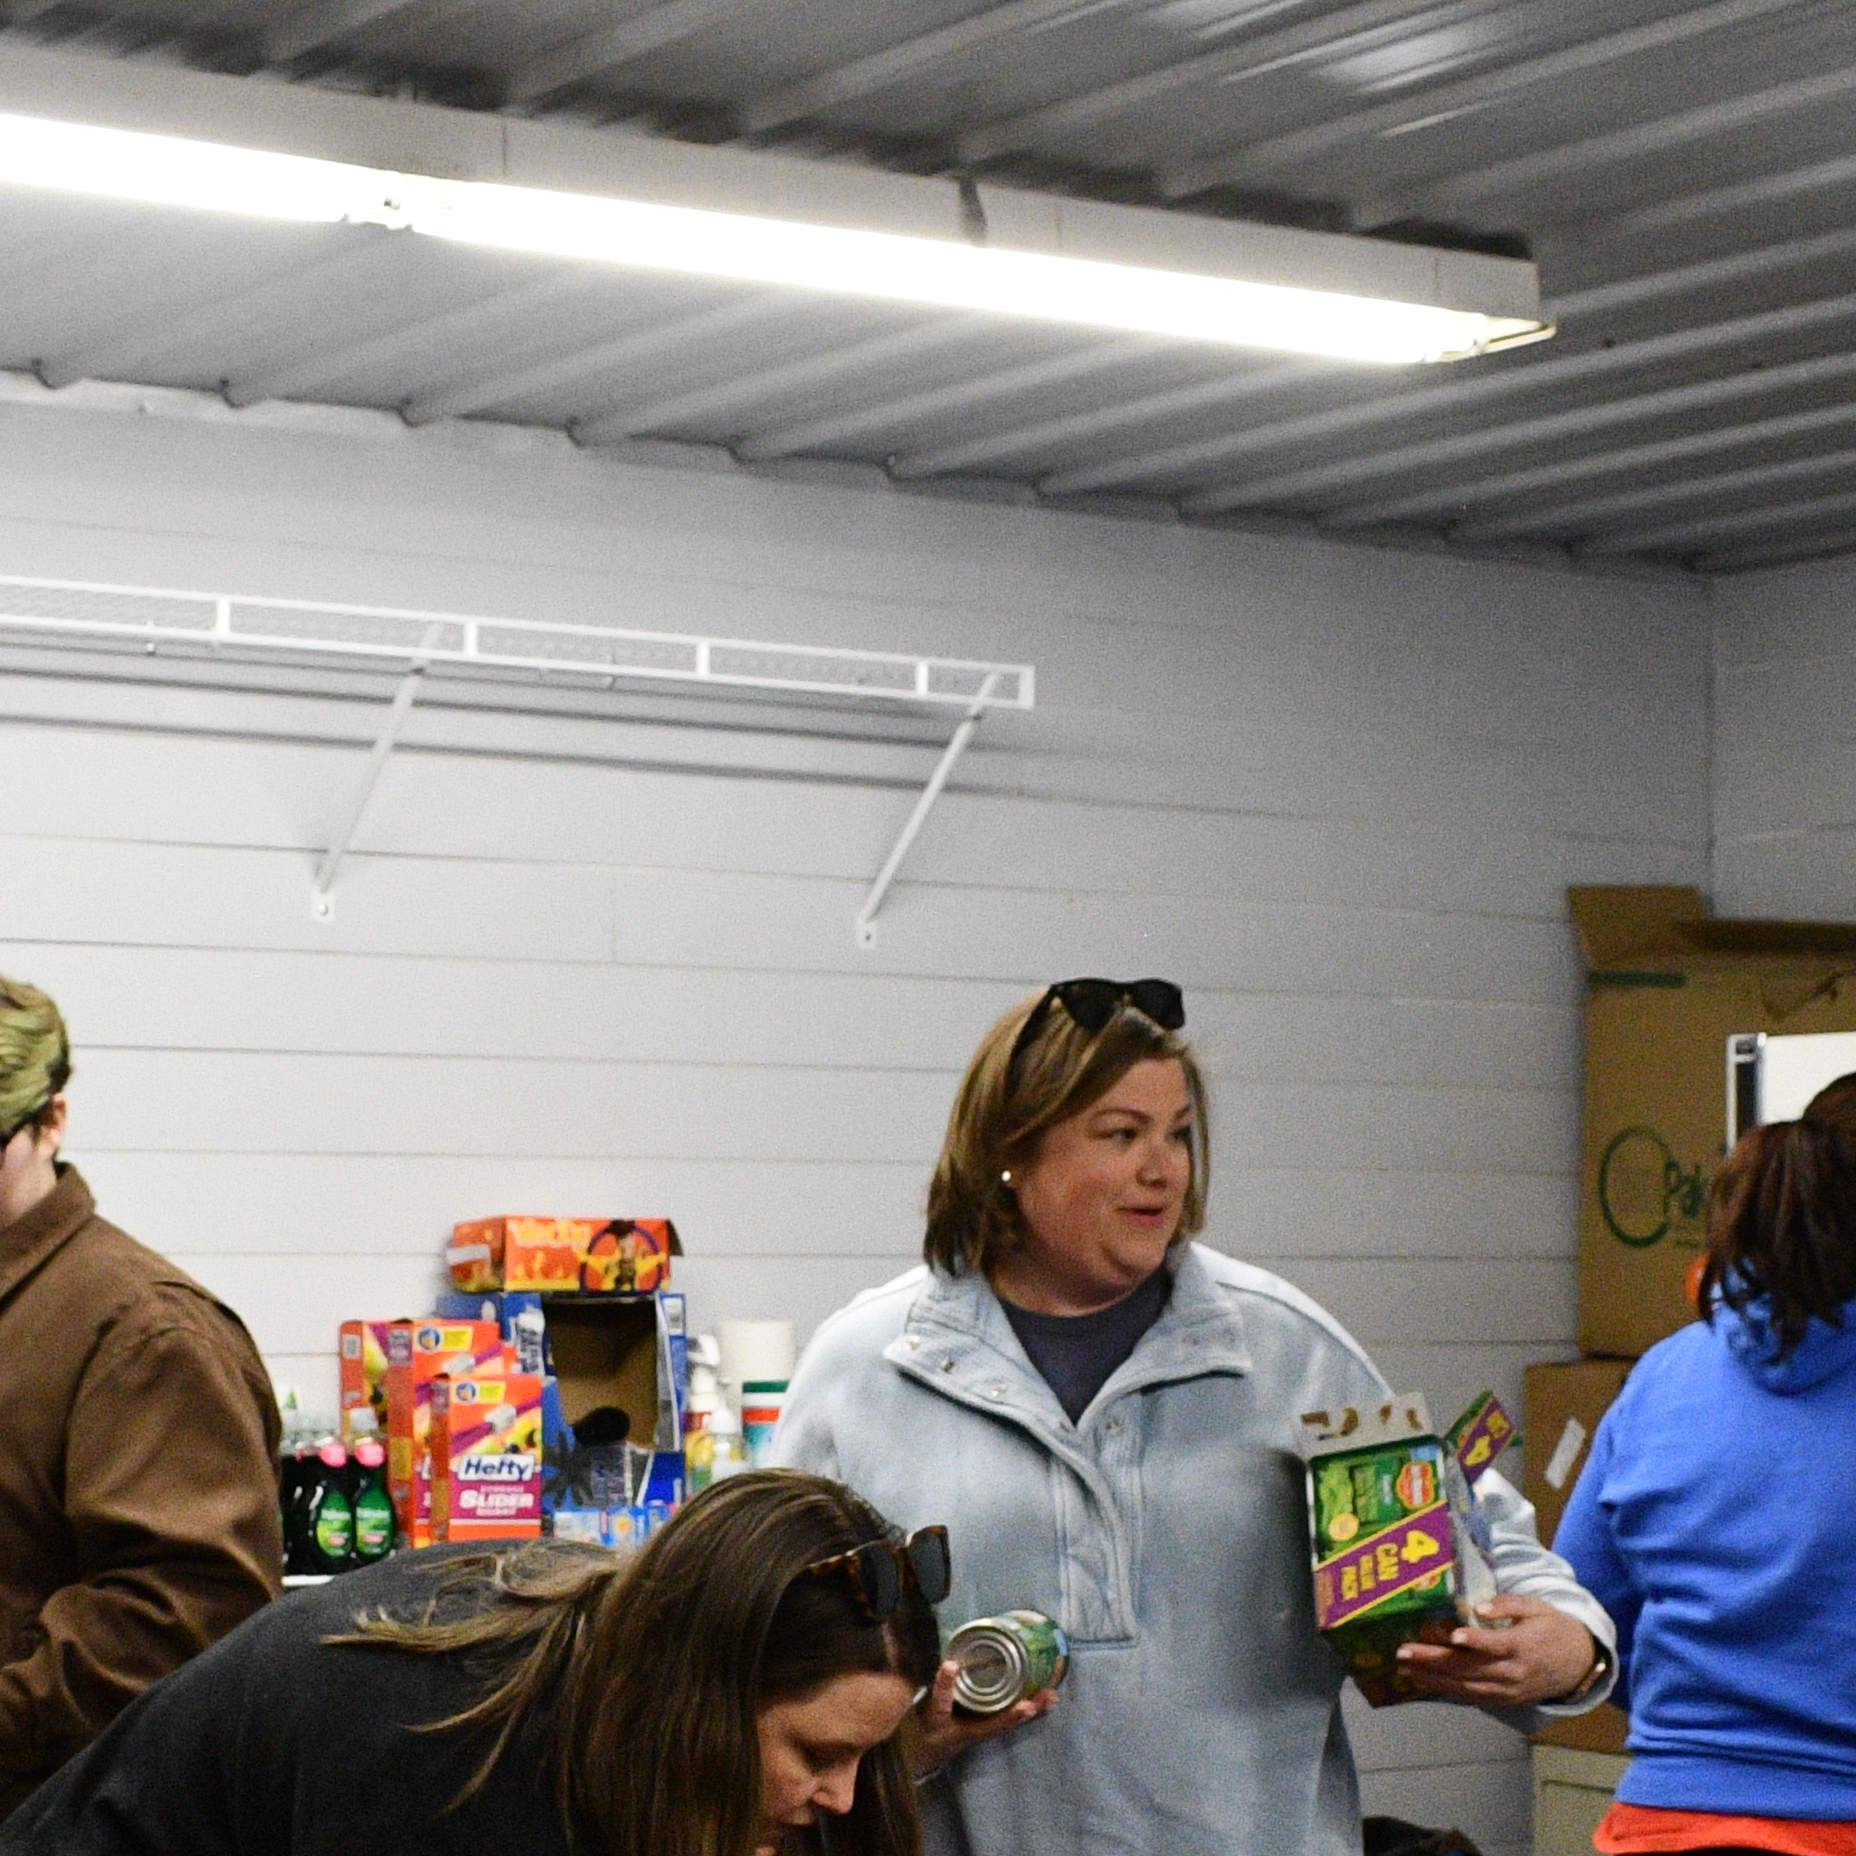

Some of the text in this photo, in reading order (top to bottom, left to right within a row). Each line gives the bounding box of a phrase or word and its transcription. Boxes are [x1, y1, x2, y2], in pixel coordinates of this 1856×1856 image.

[464, 1458, 528, 1482] Hefty
[1376, 1543, 1400, 1581] CAN
[1401, 1530, 1440, 1563] 4
